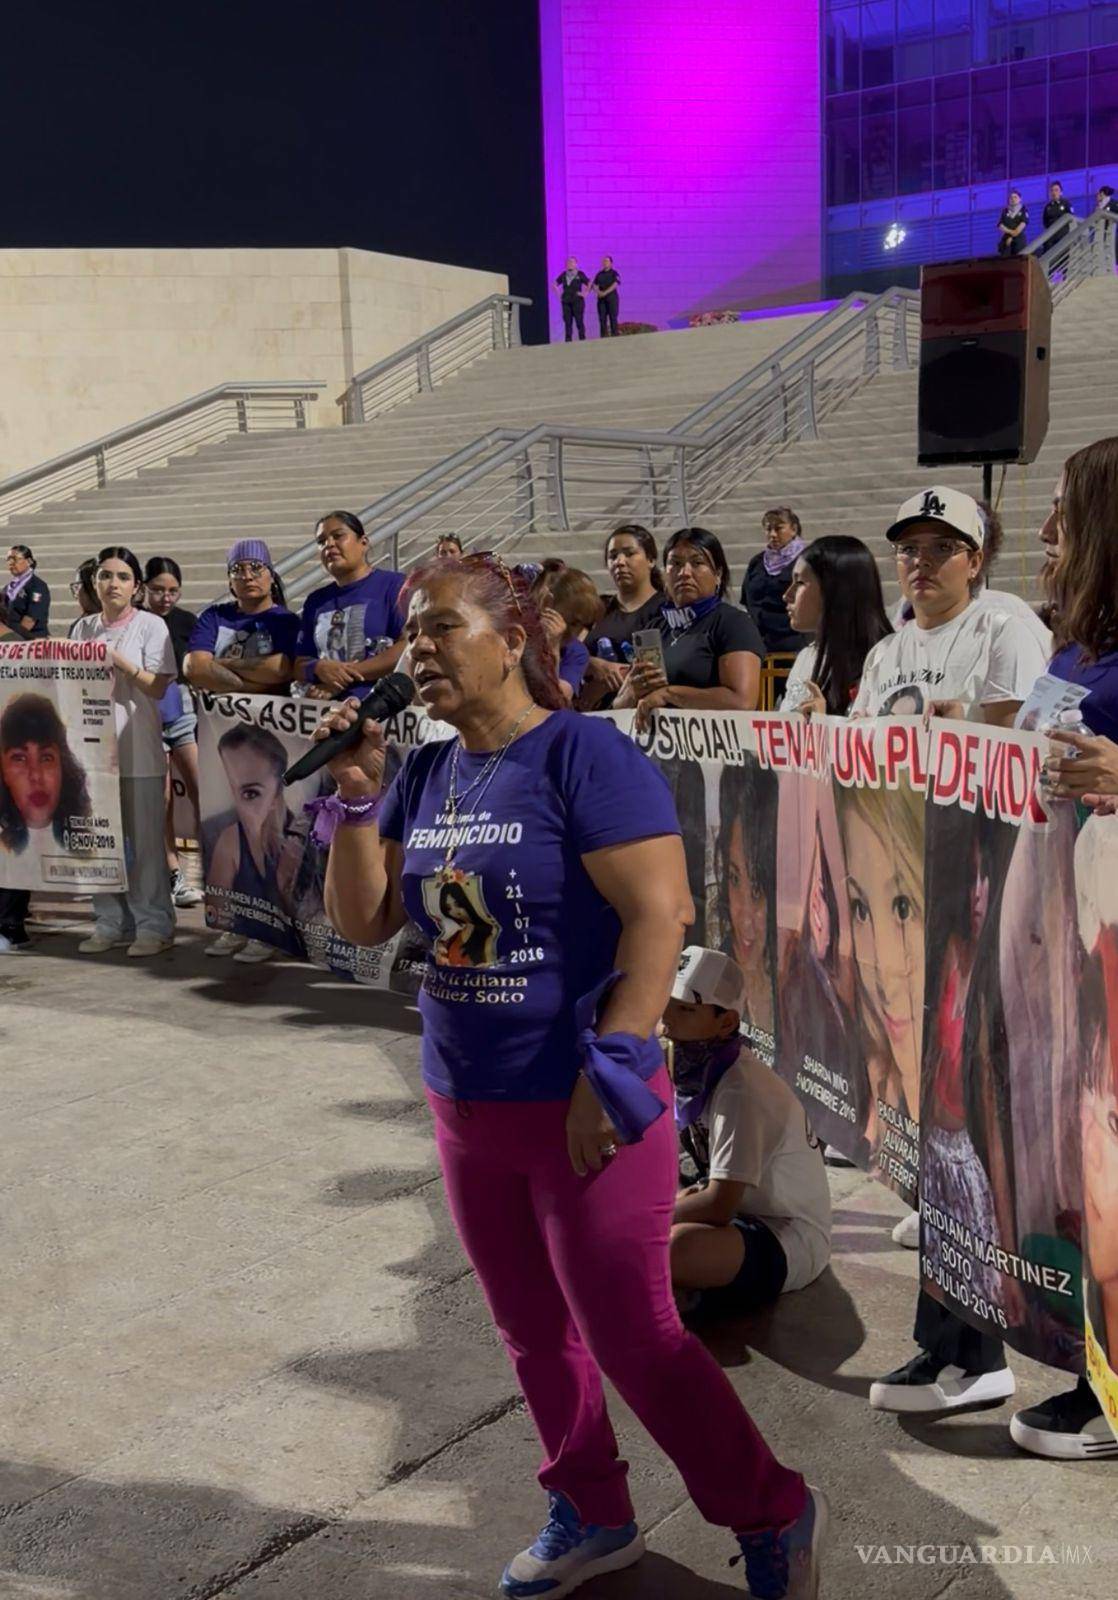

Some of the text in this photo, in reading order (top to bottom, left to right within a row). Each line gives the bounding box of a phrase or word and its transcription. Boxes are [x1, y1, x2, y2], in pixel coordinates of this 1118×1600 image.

[919, 490, 946, 517] LA
[9, 644, 26, 660] DE
[27, 640, 108, 661] FEMINICIDIO
[19, 665, 60, 680] GUADALUPE
[61, 666, 84, 680] TREJO
[635, 715, 744, 762] USTICIA!!
[835, 726, 878, 782] UN
[886, 726, 928, 785] PL
[934, 731, 980, 804] DE
[477, 811, 492, 822] de
[406, 822, 523, 849] FEMINICIDIO
[204, 885, 224, 897] ANA
[505, 885, 524, 900] 21
[230, 903, 273, 926] NOVIEMBRE
[514, 916, 530, 930] 07
[510, 948, 544, 963] 2016
[475, 991, 525, 1004] Soto
[799, 1075, 839, 1113] NOVIEMBRE
[838, 1100, 857, 1123] 2016
[878, 1099, 905, 1131] PAOLA
[941, 1240, 973, 1281] SOTO
[974, 1235, 1073, 1297] MARTINEZ
